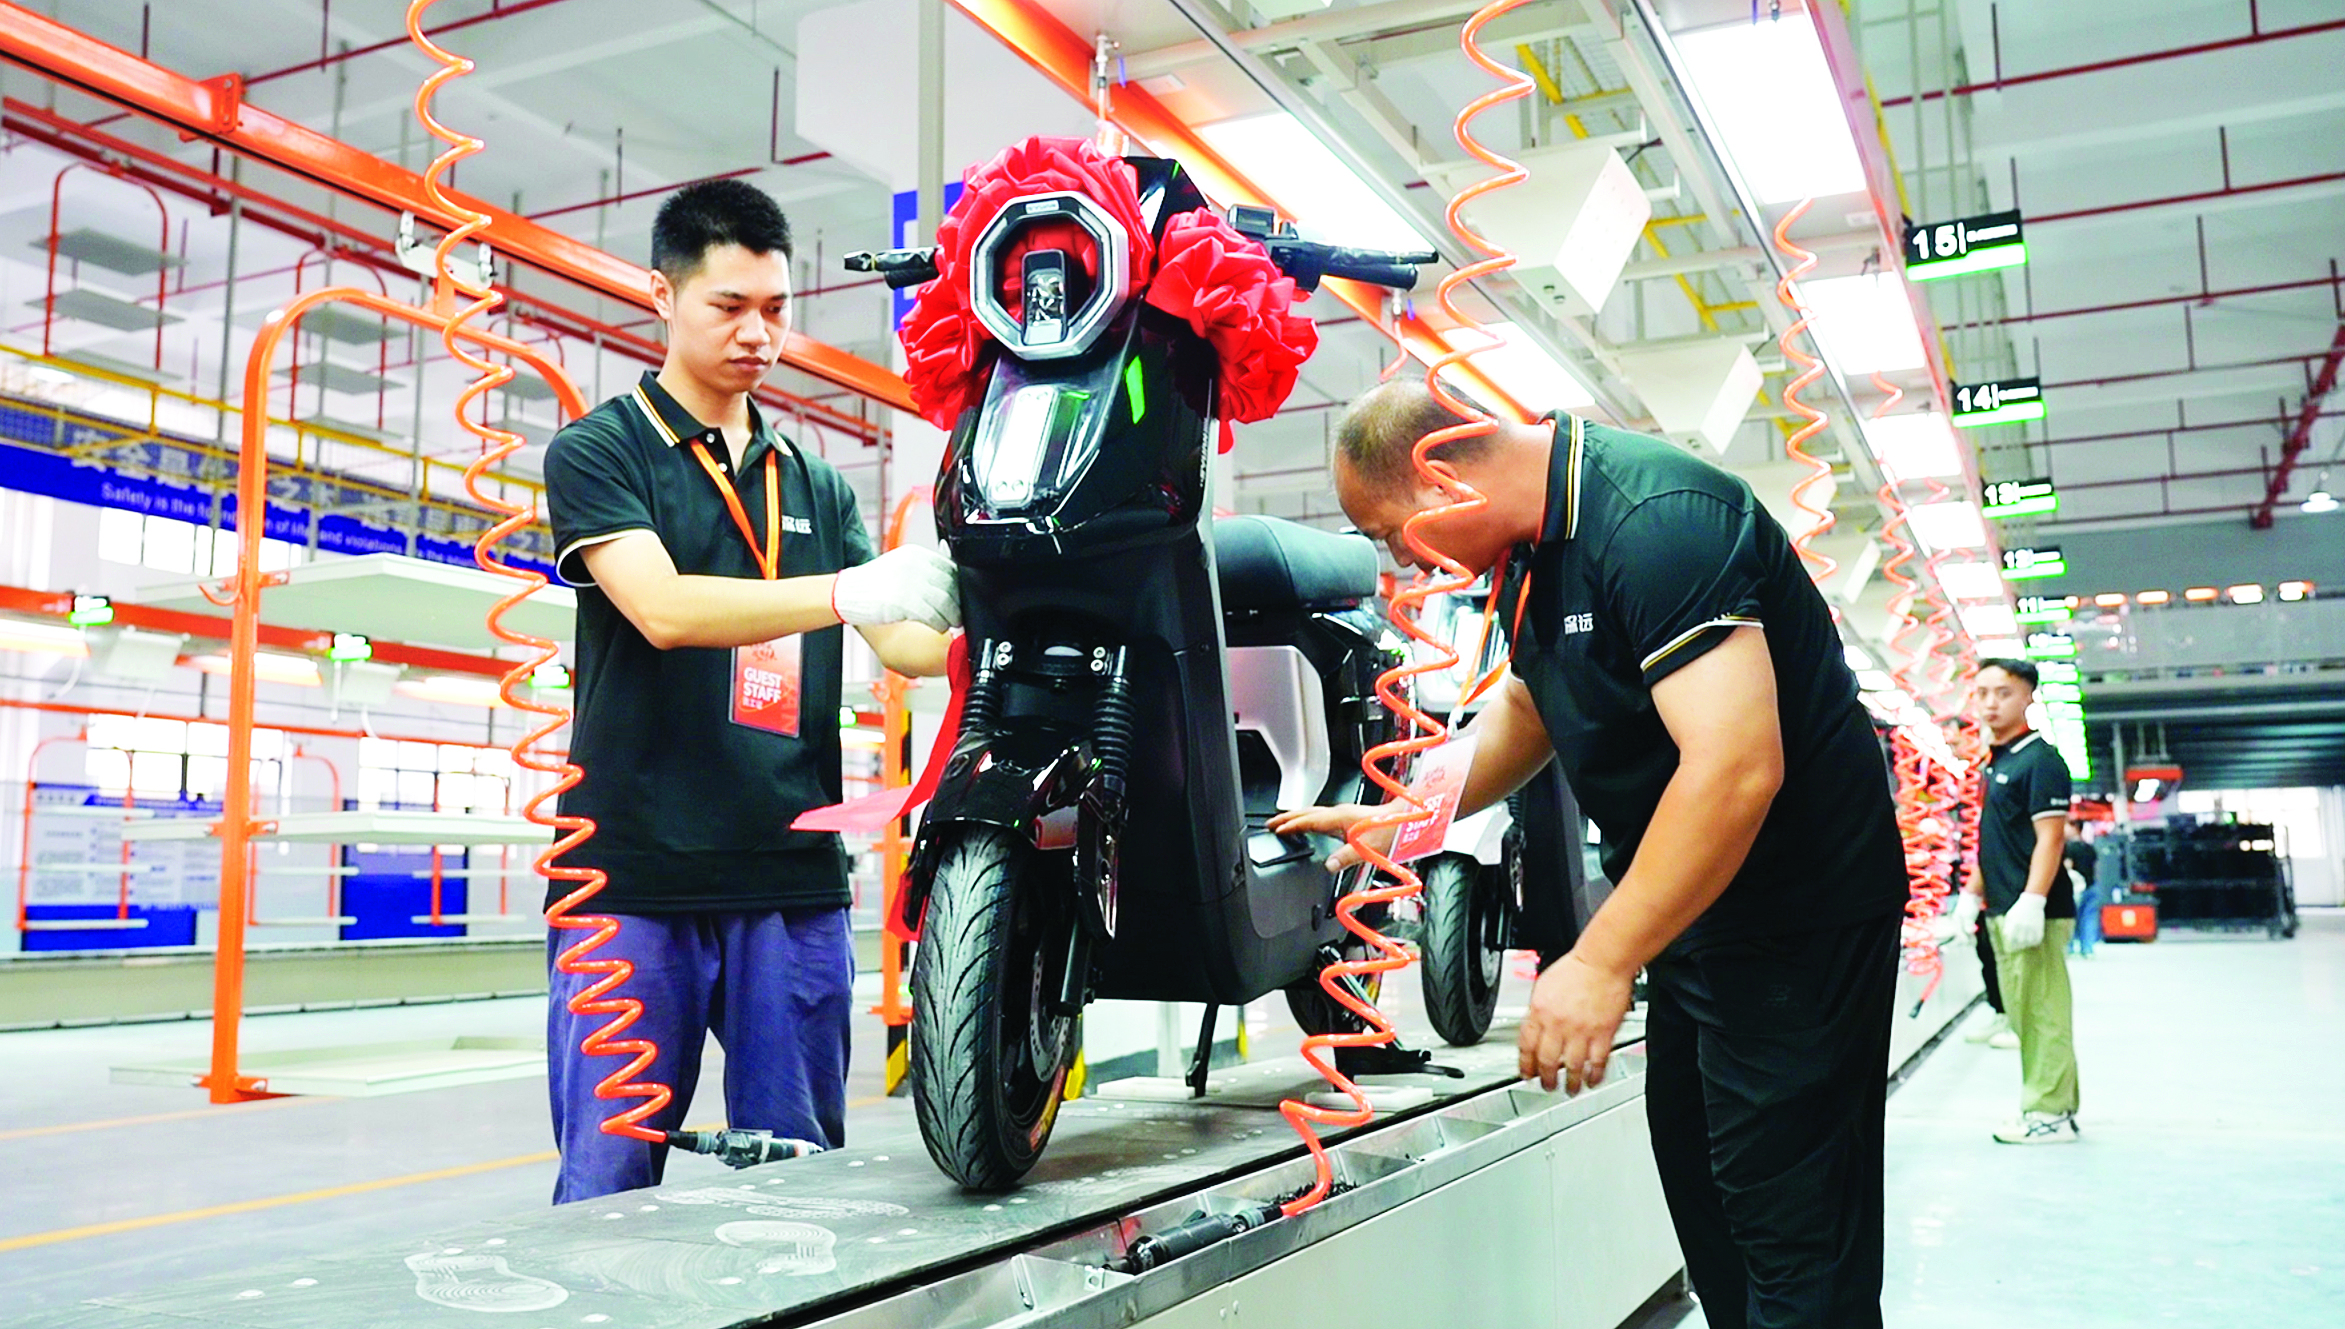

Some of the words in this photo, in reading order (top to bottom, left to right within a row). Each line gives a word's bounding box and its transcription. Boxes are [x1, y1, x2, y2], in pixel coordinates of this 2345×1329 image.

[1911, 224, 1958, 260] 15
[1956, 384, 1993, 413] 14
[101, 482, 152, 507] Safety
[153, 493, 169, 511] is
[170, 496, 196, 517] the
[743, 666, 783, 689] GUEST
[743, 681, 782, 704] STAFF
